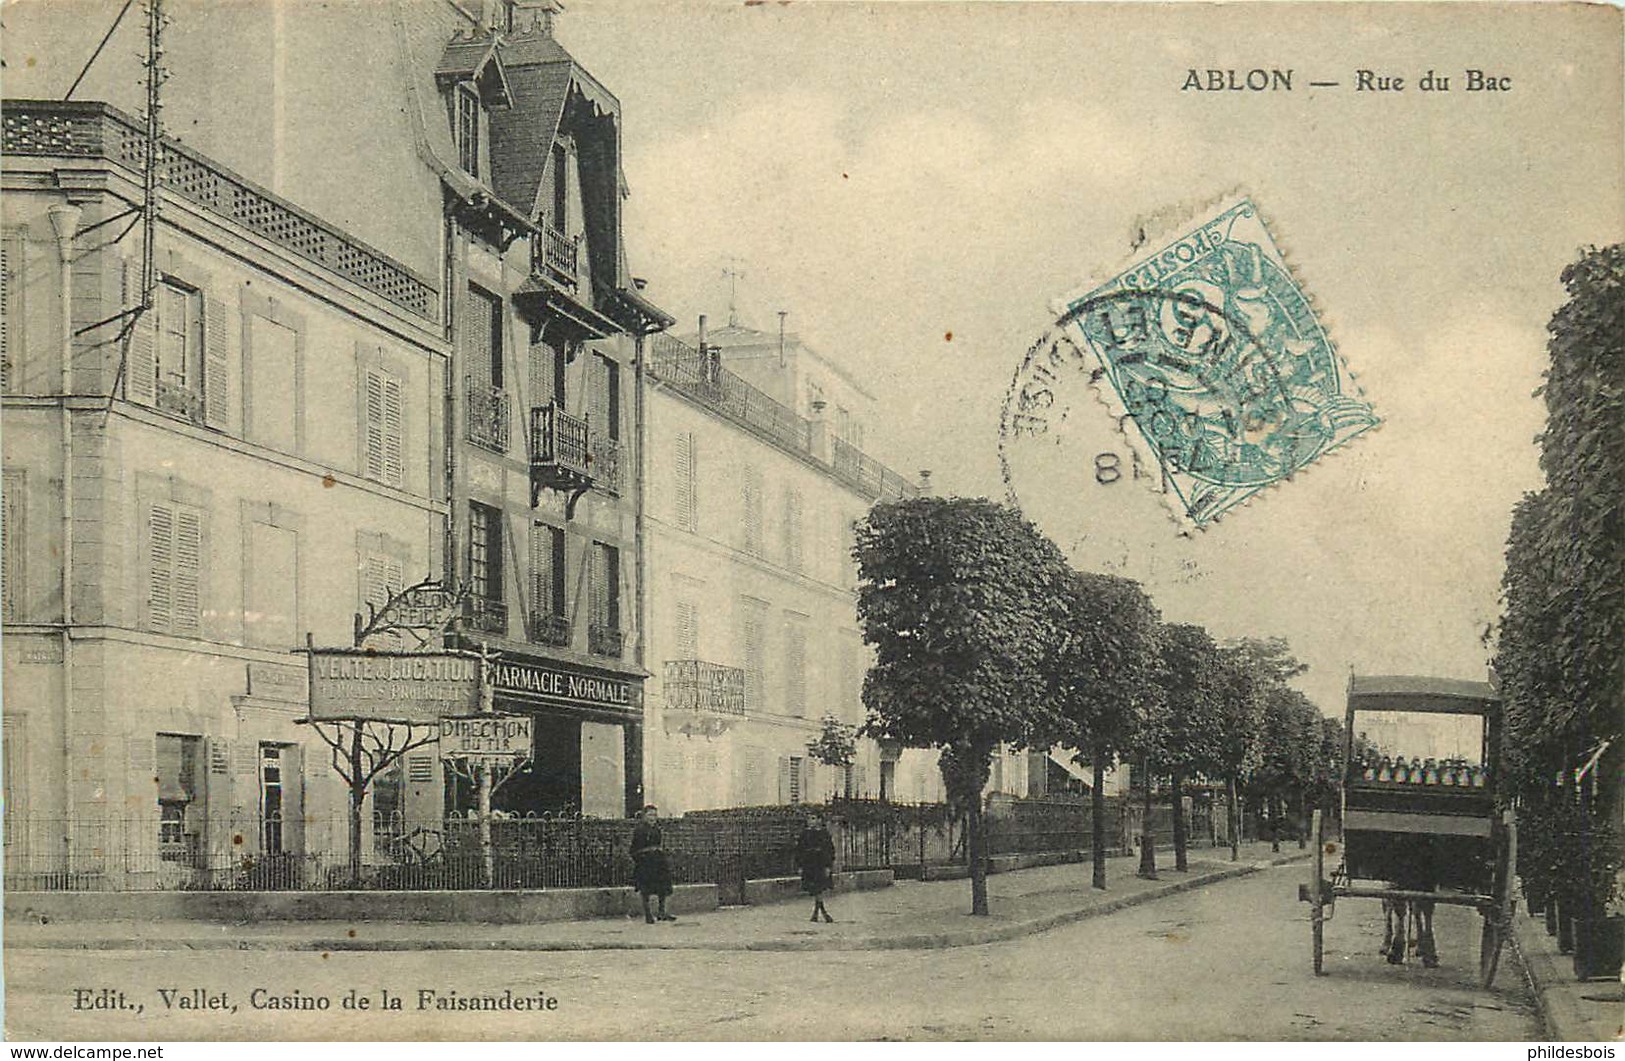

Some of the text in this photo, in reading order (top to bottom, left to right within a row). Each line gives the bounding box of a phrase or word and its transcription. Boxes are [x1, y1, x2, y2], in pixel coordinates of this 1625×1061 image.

[1181, 68, 1294, 92] ABLON
[1356, 69, 1404, 92] Rue
[1419, 69, 1450, 92] du
[1465, 69, 1513, 92] Bac
[1126, 228, 1212, 291] POSTES
[317, 656, 373, 680] VENTE
[390, 656, 475, 682] LOCATION
[483, 662, 629, 704] PHARMACIE NORMALE
[441, 720, 529, 739] DIRECTION
[73, 988, 558, 1014] Edit., Vallet, Casino de la Faisanderie
